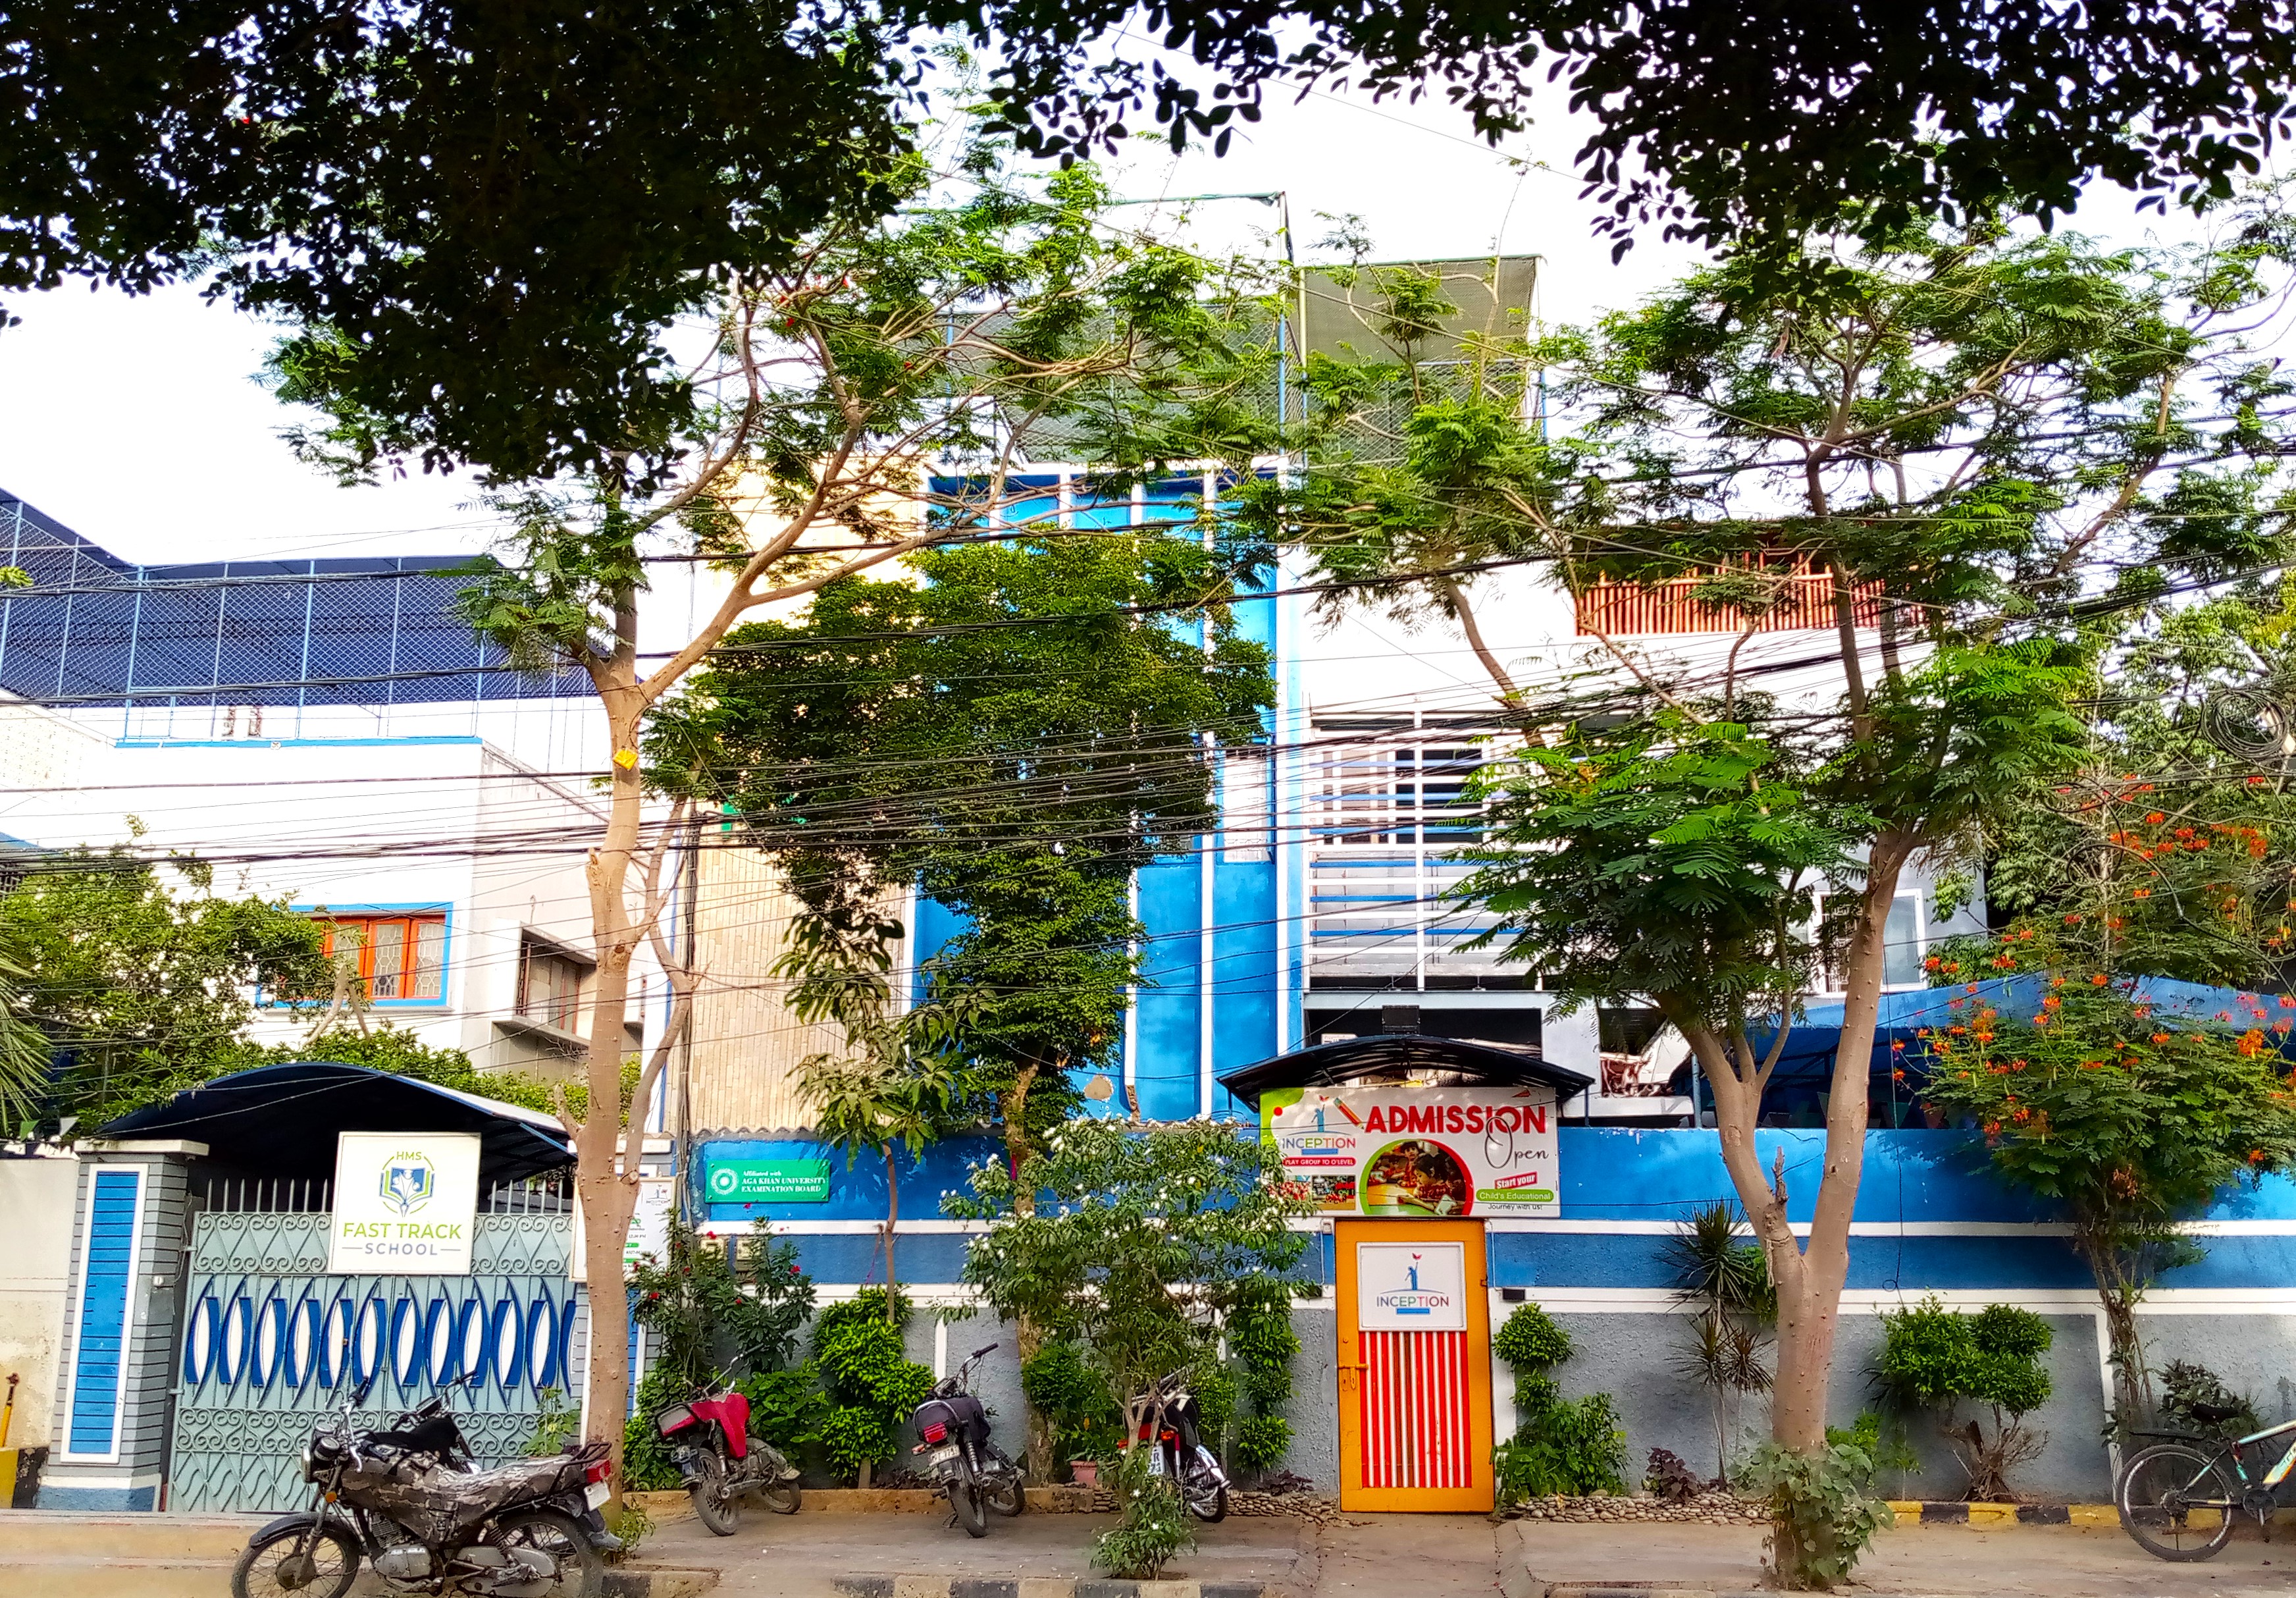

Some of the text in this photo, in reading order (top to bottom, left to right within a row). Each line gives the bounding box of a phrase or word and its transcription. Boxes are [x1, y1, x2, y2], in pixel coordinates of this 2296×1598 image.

[1364, 1105, 1546, 1133] ADMISSION
[1282, 1138, 1356, 1149] INCEPTION
[1484, 1116, 1549, 1169] Open
[396, 1151, 422, 1161] HMS
[1496, 1175, 1536, 1189] Start your
[343, 1222, 462, 1240] FAST TRACK
[365, 1242, 438, 1256] SCHOOL
[1376, 1296, 1449, 1307] INCEPTION
